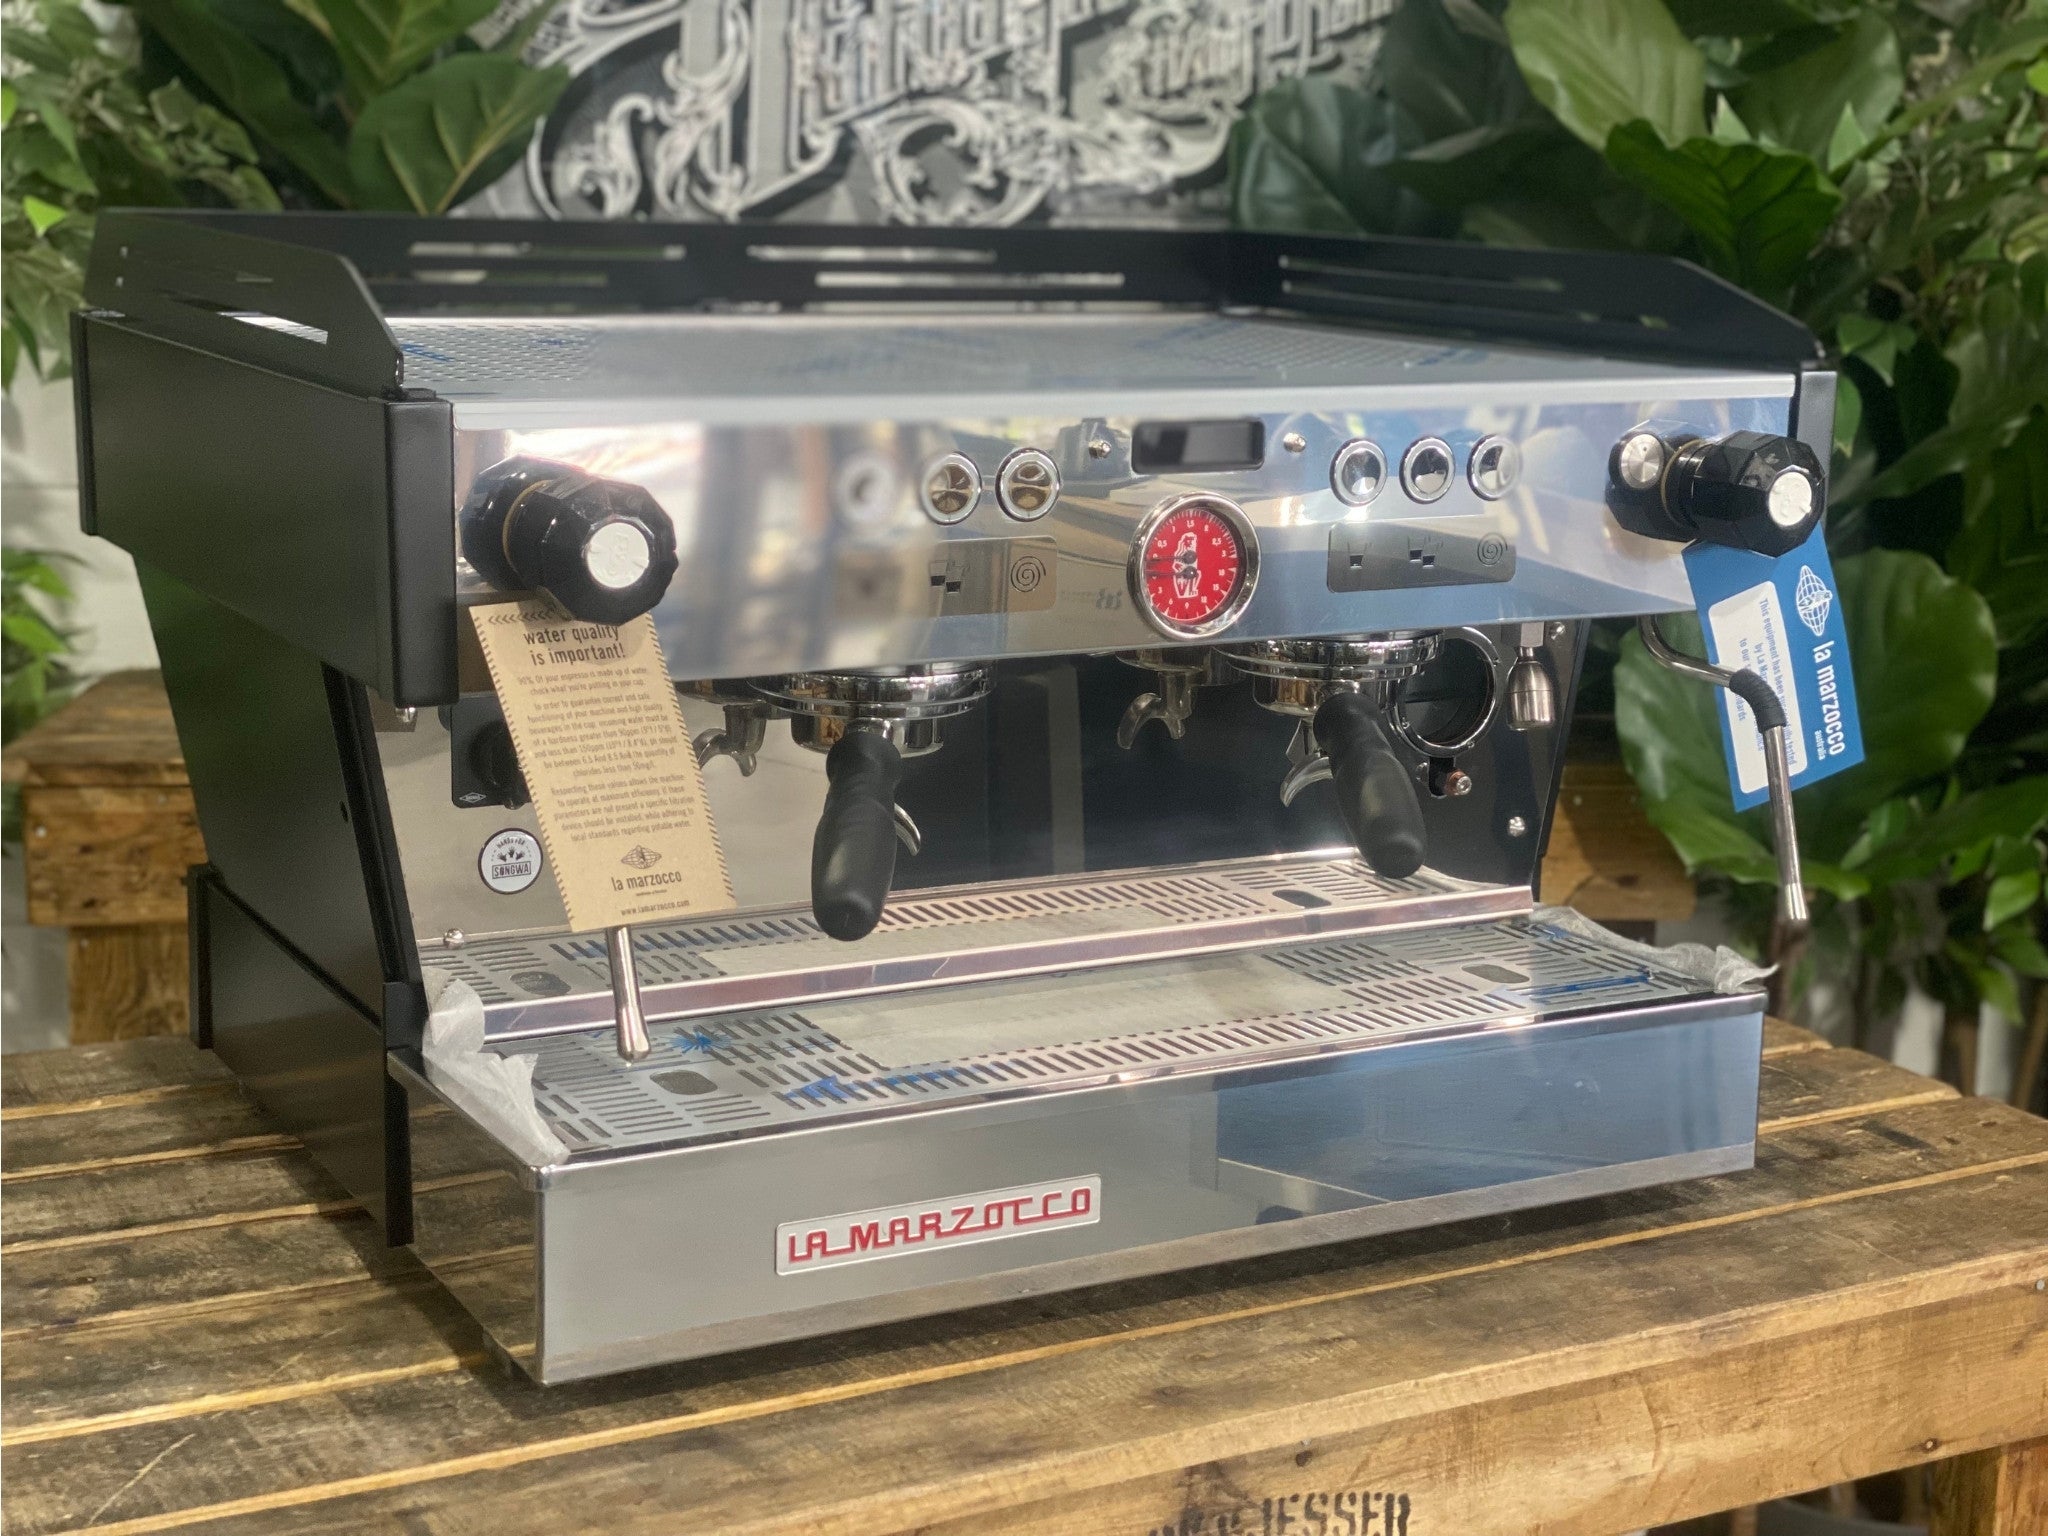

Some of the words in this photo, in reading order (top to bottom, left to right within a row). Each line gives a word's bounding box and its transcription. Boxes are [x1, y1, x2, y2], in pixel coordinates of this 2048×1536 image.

[1157, 540, 1167, 549] 0,5
[1759, 598, 1769, 616] This
[523, 628, 567, 645] water
[572, 624, 619, 644] quality
[1740, 638, 1748, 647] to
[1763, 618, 1779, 659] equipment
[531, 650, 545, 666] is
[550, 643, 625, 665] important!
[1741, 648, 1750, 661] our
[1813, 640, 1835, 663] la
[561, 673, 589, 681] espresso
[596, 669, 613, 677] made
[1772, 659, 1781, 675] has
[1774, 675, 1784, 695] been
[1816, 664, 1845, 756] marzocco
[1785, 742, 1797, 765] tested
[1814, 730, 1825, 760] australia
[494, 863, 529, 877] SONGWA
[611, 877, 624, 891] la
[627, 870, 682, 889] marzocco
[621, 899, 690, 917] www.lamarzocco.com
